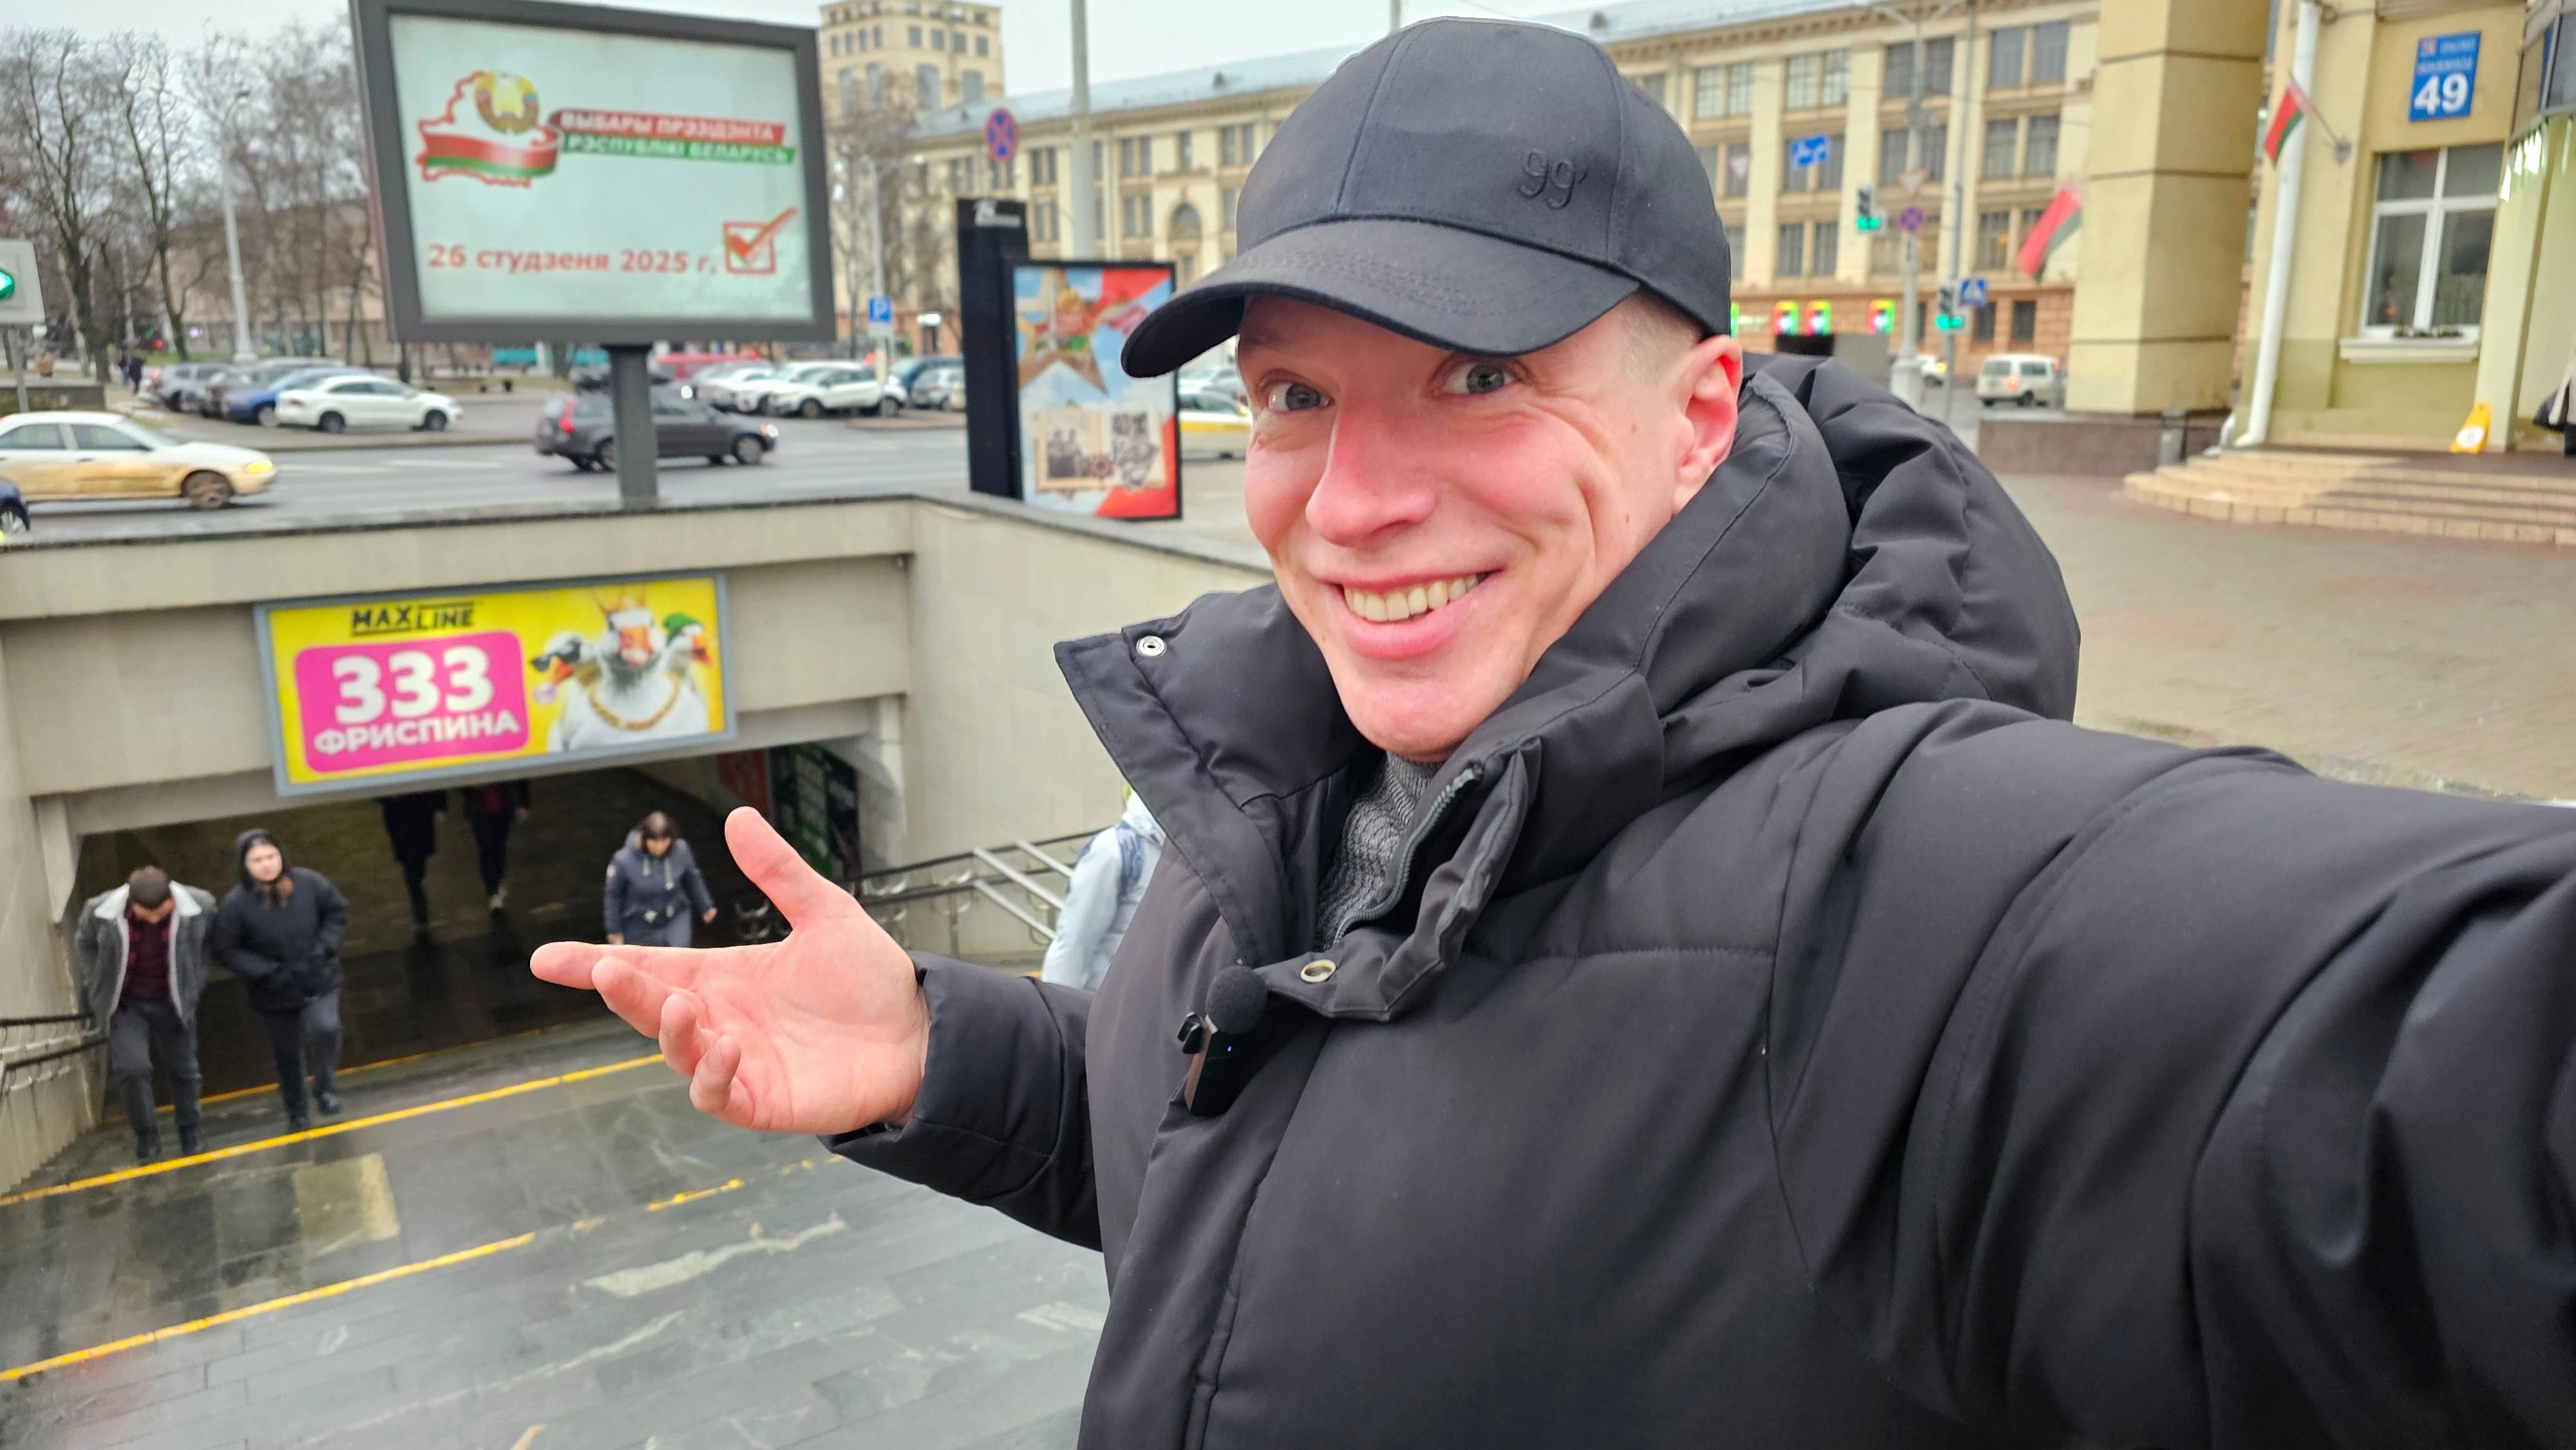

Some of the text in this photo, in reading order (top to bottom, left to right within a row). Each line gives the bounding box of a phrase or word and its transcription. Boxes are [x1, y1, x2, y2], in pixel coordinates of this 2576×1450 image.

[2414, 72, 2468, 115] 49
[560, 111, 653, 133] ВЫБАРЫ
[689, 142, 788, 162] БЕЛАРУСЬ
[427, 243, 717, 275] 26 студзеня 2025 г.
[332, 645, 494, 724] 333
[314, 710, 520, 755] ФРИСПИНА
